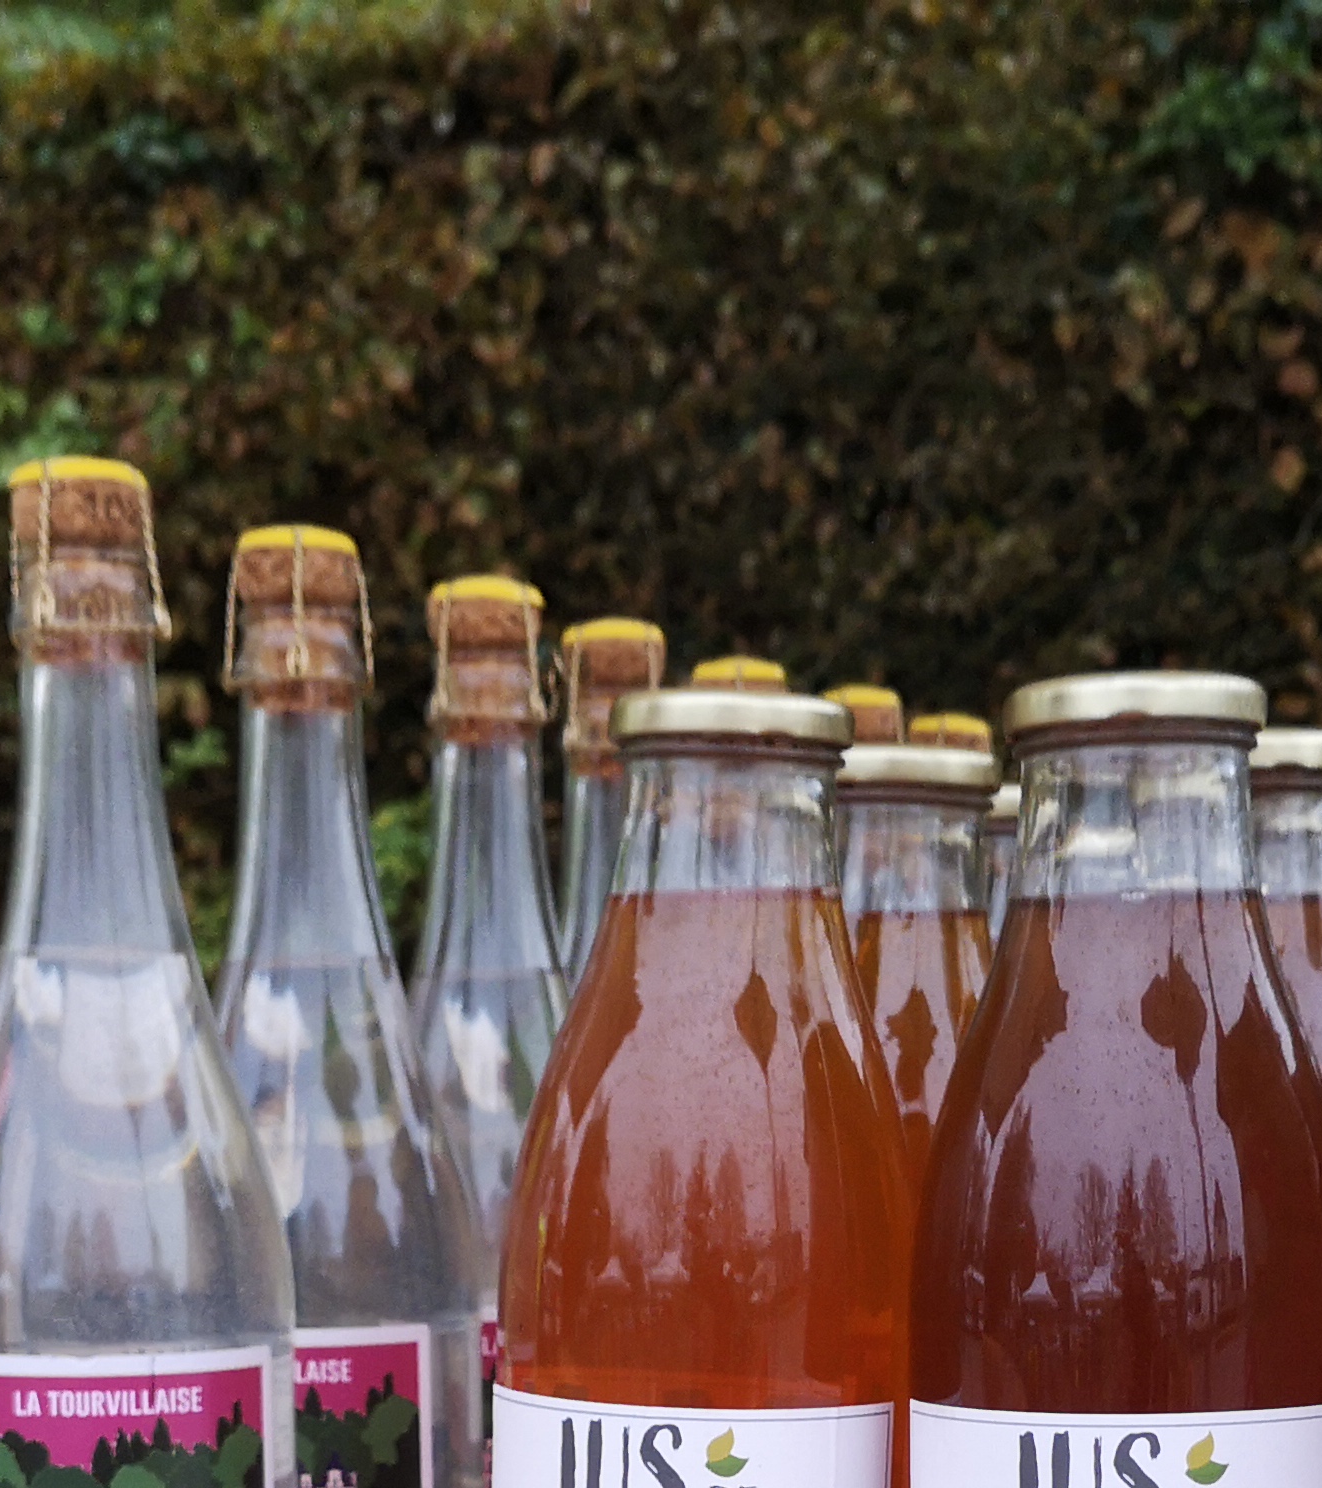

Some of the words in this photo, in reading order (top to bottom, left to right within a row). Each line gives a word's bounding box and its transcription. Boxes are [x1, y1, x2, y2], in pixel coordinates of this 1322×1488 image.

[295, 1358, 353, 1384] LAISE
[13, 1389, 42, 1418] LA
[46, 1385, 204, 1418] TOURVILLAISE
